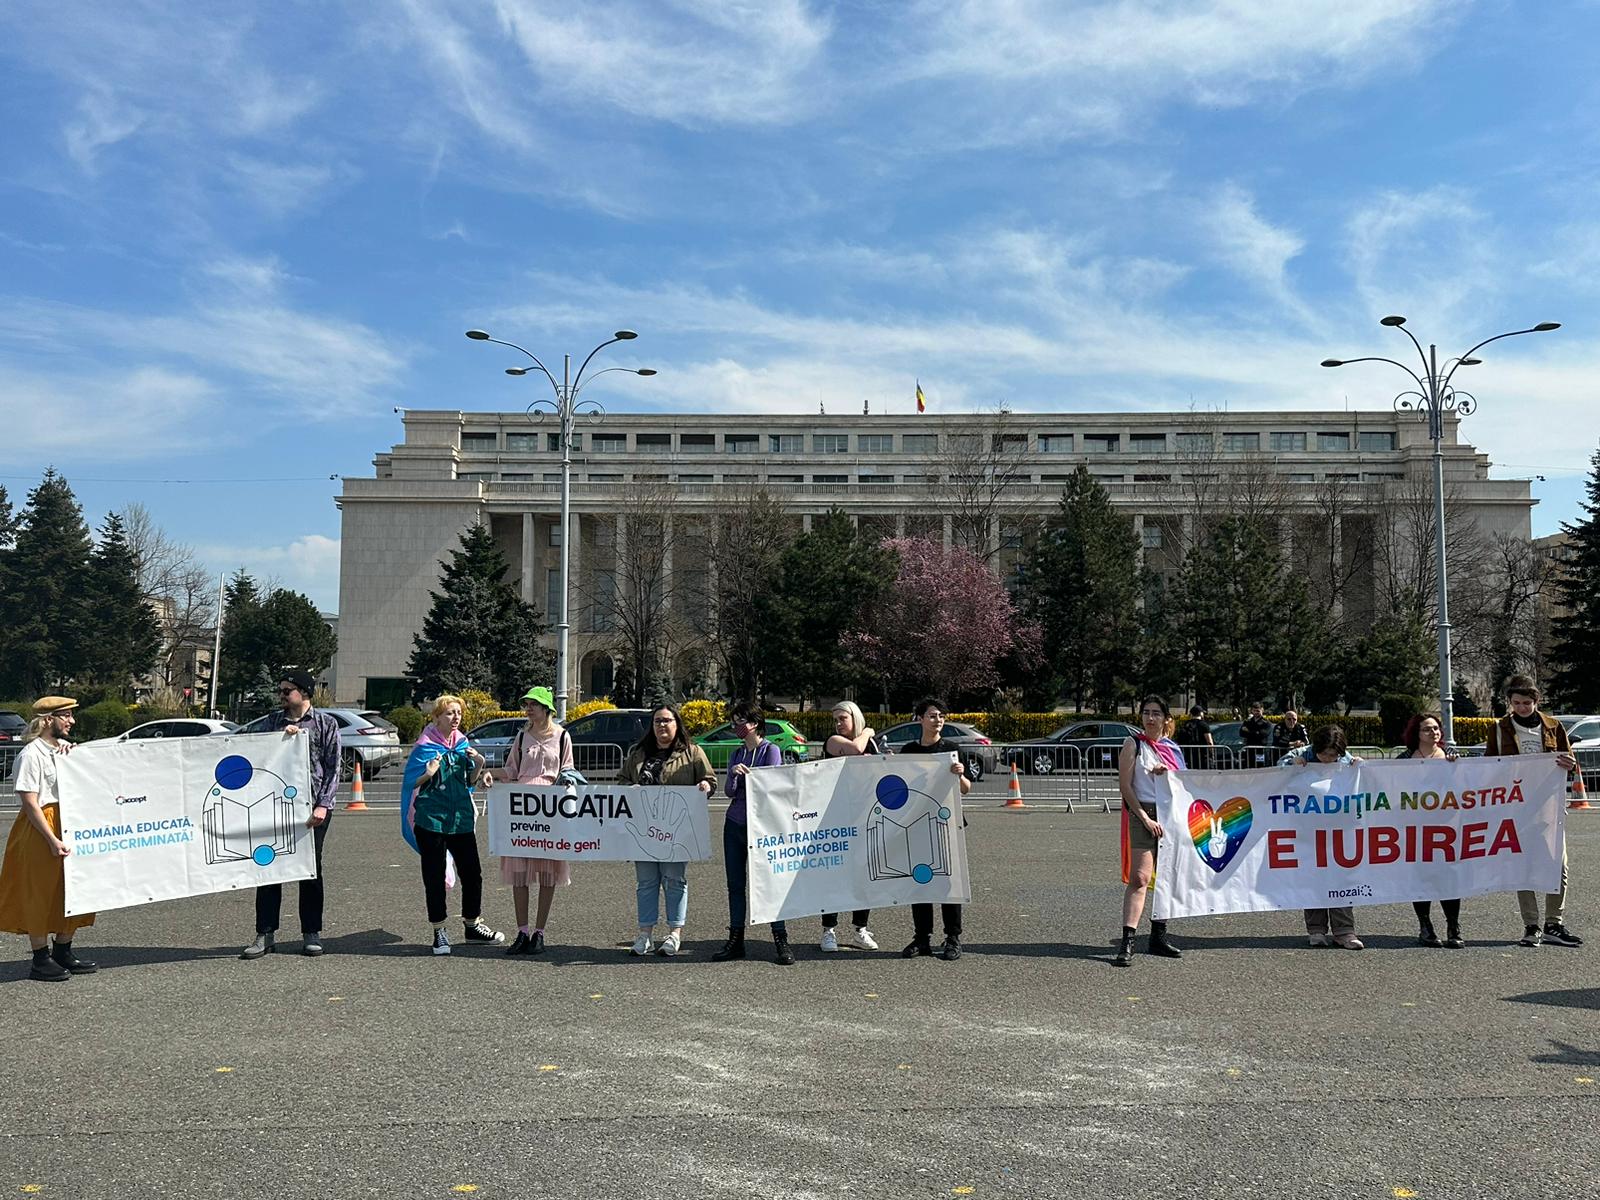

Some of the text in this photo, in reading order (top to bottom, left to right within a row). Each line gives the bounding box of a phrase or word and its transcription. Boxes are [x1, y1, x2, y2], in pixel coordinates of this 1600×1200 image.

[1400, 779, 1525, 811] NOASTRĂ
[509, 792, 633, 827] EDUCAȚIA
[75, 824, 133, 840] ROMÂNIA
[510, 820, 551, 832] previne
[76, 829, 194, 856] NU DISCRIMINATĂ!
[511, 835, 601, 853] violența de gen!
[757, 826, 858, 848] FĂRĂ TRANSFOBIE
[1268, 818, 1522, 869] E IUBIREA
[779, 841, 849, 859] HOMOFOBIE
[773, 854, 844, 874] ÎN EDUCAȚIE!
